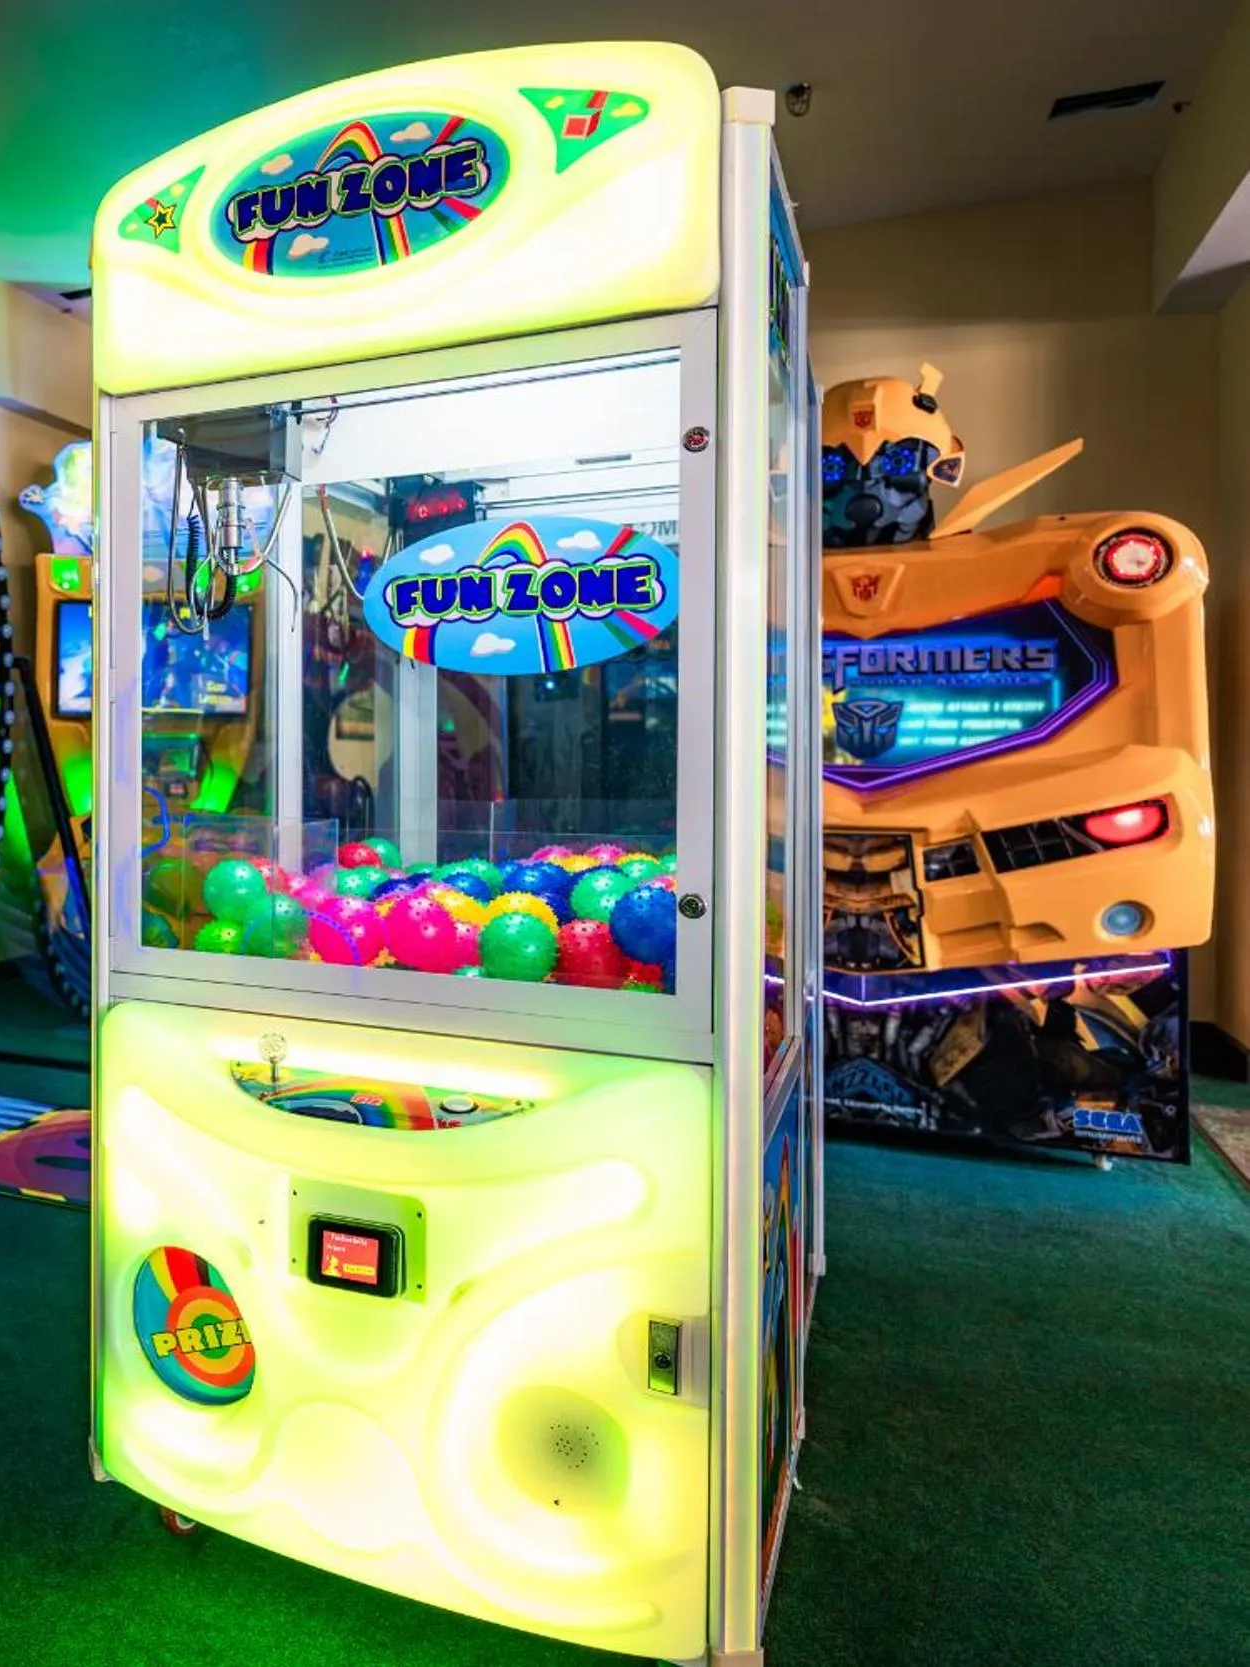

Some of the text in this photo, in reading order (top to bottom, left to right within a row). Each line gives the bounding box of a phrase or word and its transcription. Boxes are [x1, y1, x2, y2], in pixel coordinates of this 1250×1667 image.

[234, 143, 483, 236] FUN ZONE
[388, 561, 656, 619] FUN ZONE
[1073, 1108, 1142, 1135] SEGA
